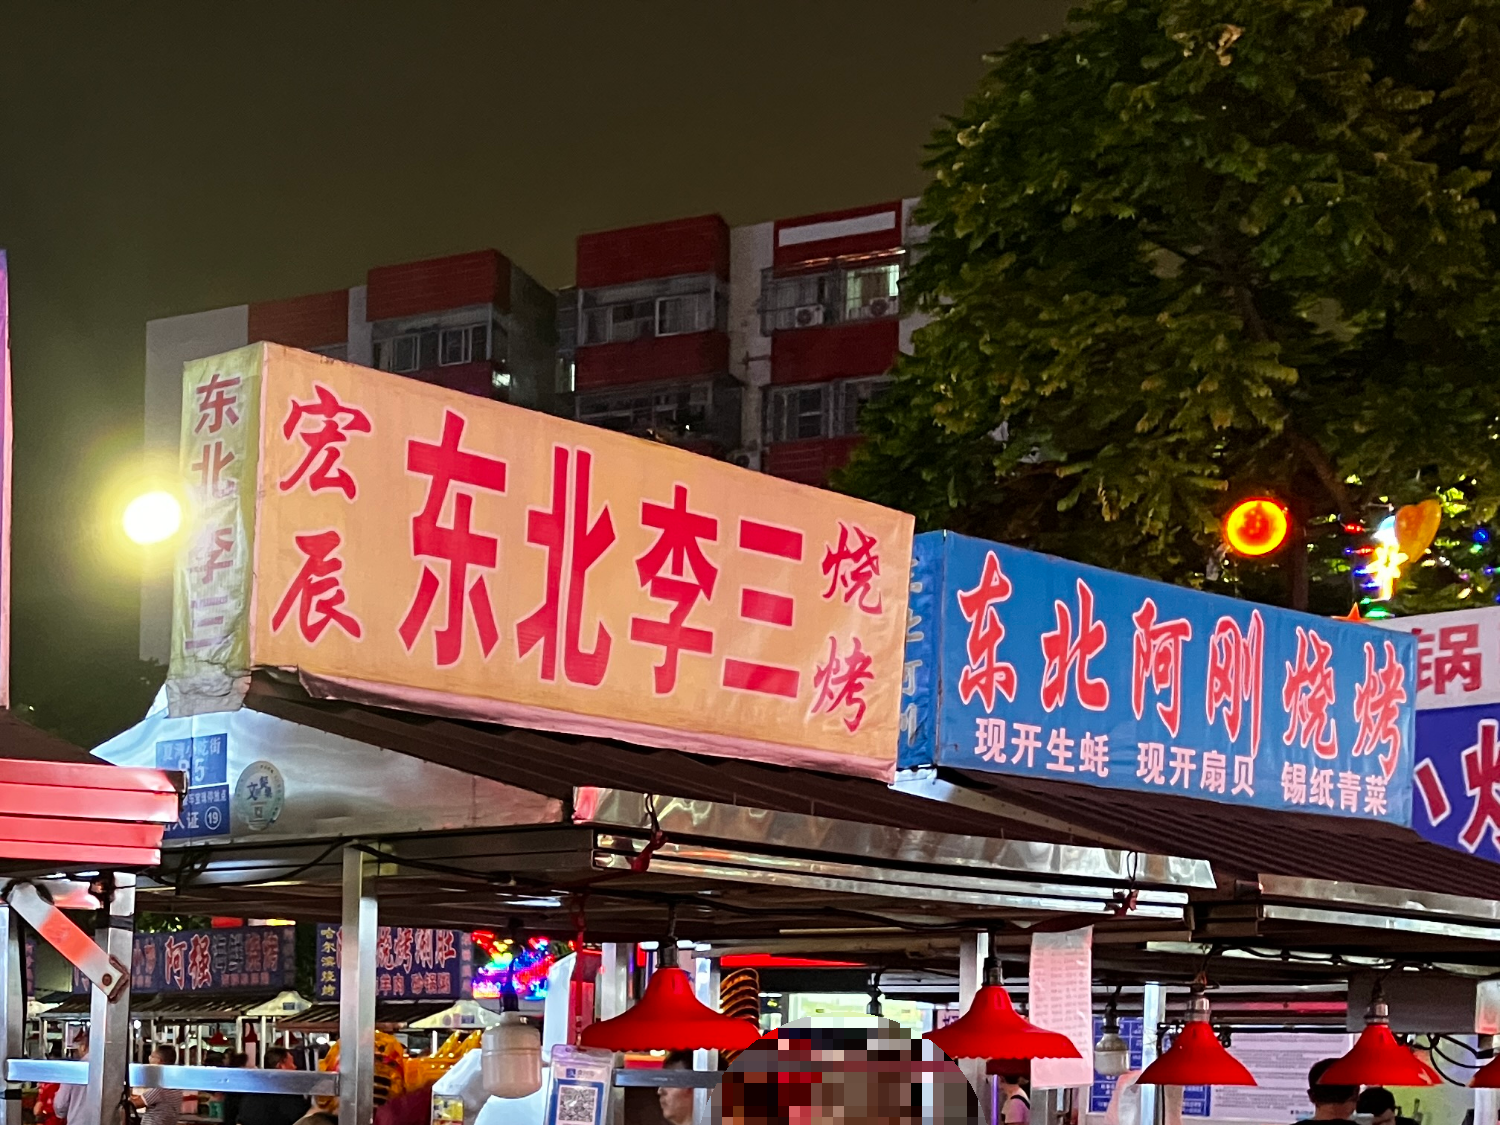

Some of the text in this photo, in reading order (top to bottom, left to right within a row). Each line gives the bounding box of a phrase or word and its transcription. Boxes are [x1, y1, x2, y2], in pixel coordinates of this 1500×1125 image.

[270, 383, 373, 646] 宏辰
[397, 408, 804, 700] 东北李三
[811, 520, 884, 735] 烧烤
[956, 549, 1409, 781] 东北阿刚烧烤
[974, 717, 1109, 777] 现开生蚝
[1136, 742, 1255, 798] 现开扇贝
[1280, 761, 1388, 816] 锡纸青菜
[376, 972, 405, 997] 羊肉
